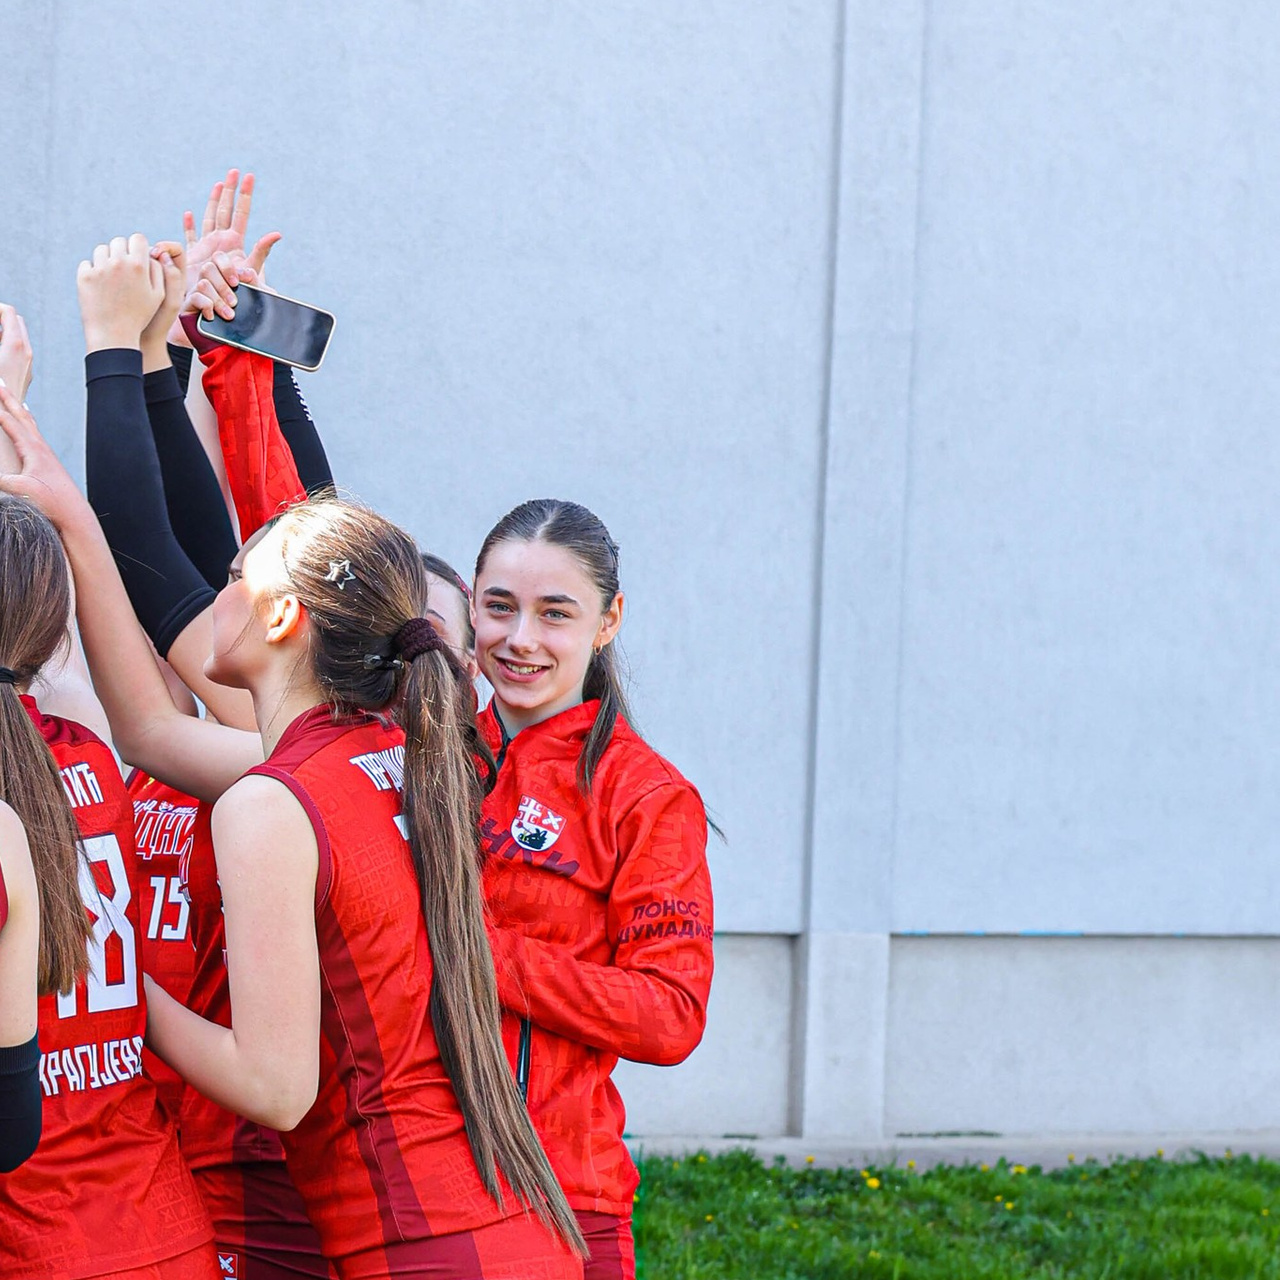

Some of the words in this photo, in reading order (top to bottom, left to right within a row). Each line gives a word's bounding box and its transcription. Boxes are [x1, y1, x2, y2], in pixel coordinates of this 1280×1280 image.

[57, 833, 138, 1020] 8
[147, 876, 190, 940] 15
[631, 899, 700, 922] ПОНОС
